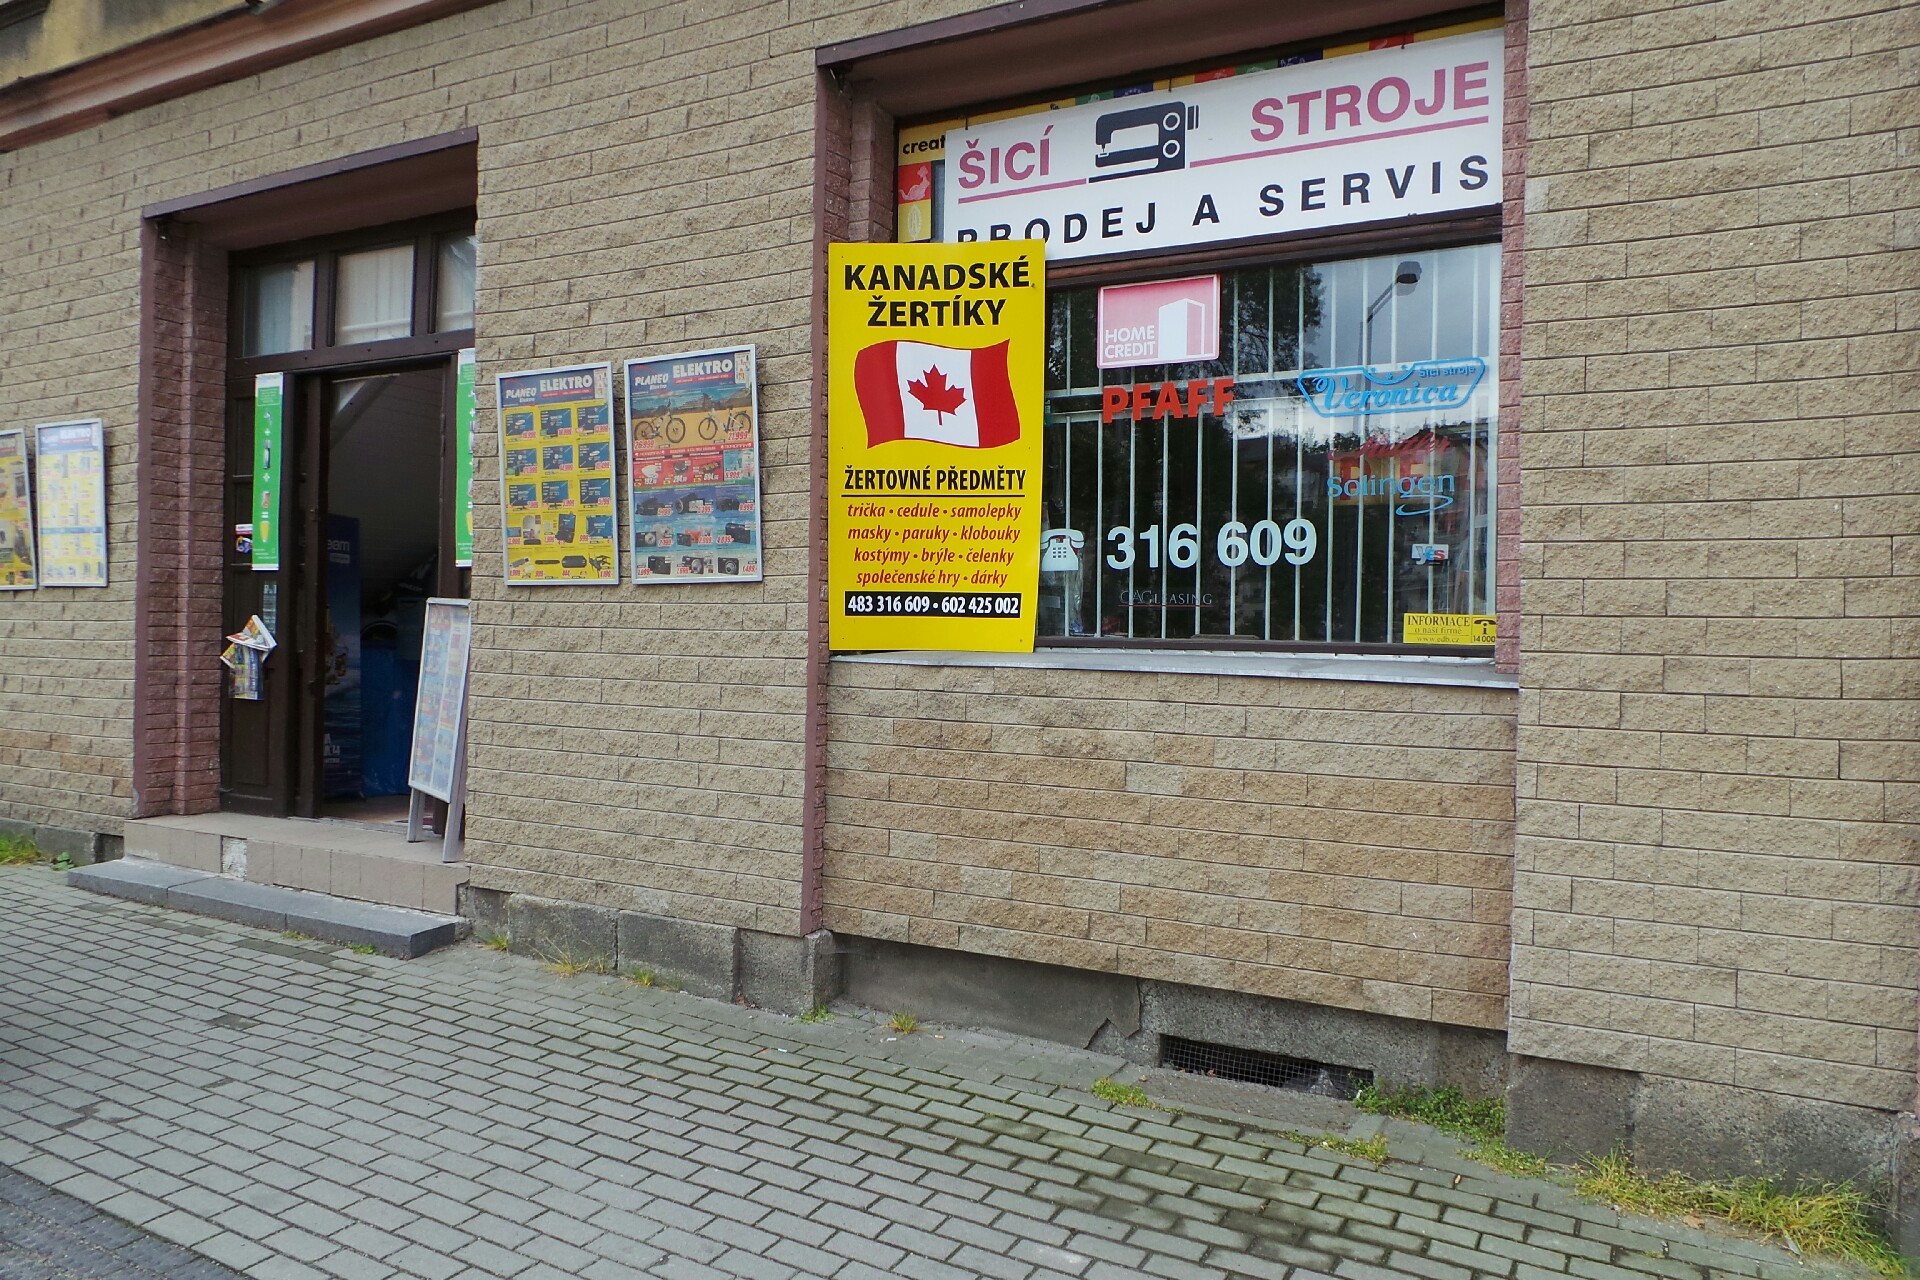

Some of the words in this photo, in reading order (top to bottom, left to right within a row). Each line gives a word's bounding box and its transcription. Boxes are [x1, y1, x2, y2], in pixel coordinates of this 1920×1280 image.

[958, 124, 1054, 189] ŠICÍ
[1250, 61, 1489, 142] STROJE
[1192, 194, 1220, 227] A
[1259, 155, 1489, 217] SERVIS
[844, 255, 1030, 291] KANADSKÉ
[867, 294, 1007, 327] ŽERTÍKY
[1105, 325, 1155, 344] HOME
[1104, 341, 1155, 359] CREDIT
[672, 359, 733, 378] ELEKTRO
[540, 374, 593, 392] ELEKTRO
[634, 373, 669, 386] PLANEO
[505, 387, 537, 399] PLANEO
[1102, 378, 1235, 424] PFAFF
[1312, 376, 1458, 410] Veronica
[844, 465, 931, 490] ŽERTOVNÉ
[936, 465, 1027, 491] PŘEDMĚTY
[1327, 473, 1455, 498] Solingen
[847, 503, 886, 517] trička
[897, 503, 940, 517] cedule
[950, 503, 1022, 521] samolepky
[847, 525, 892, 543] masky
[902, 525, 950, 543] paruky
[960, 525, 1021, 543] klobouky
[1106, 523, 1199, 570] 316
[1217, 518, 1317, 567] 609
[854, 547, 910, 565] kostýmy
[921, 547, 955, 565] brýle
[966, 547, 1014, 566] čelenky
[856, 569, 935, 587] společenské
[938, 569, 960, 587] hry
[971, 569, 1008, 588] dárky
[847, 595, 873, 612] 483
[877, 595, 902, 612] 316
[904, 595, 930, 612] 609
[941, 596, 966, 613] 602
[968, 597, 992, 613] 425
[994, 597, 1019, 614] 002
[1407, 615, 1470, 627] INFORMACE
